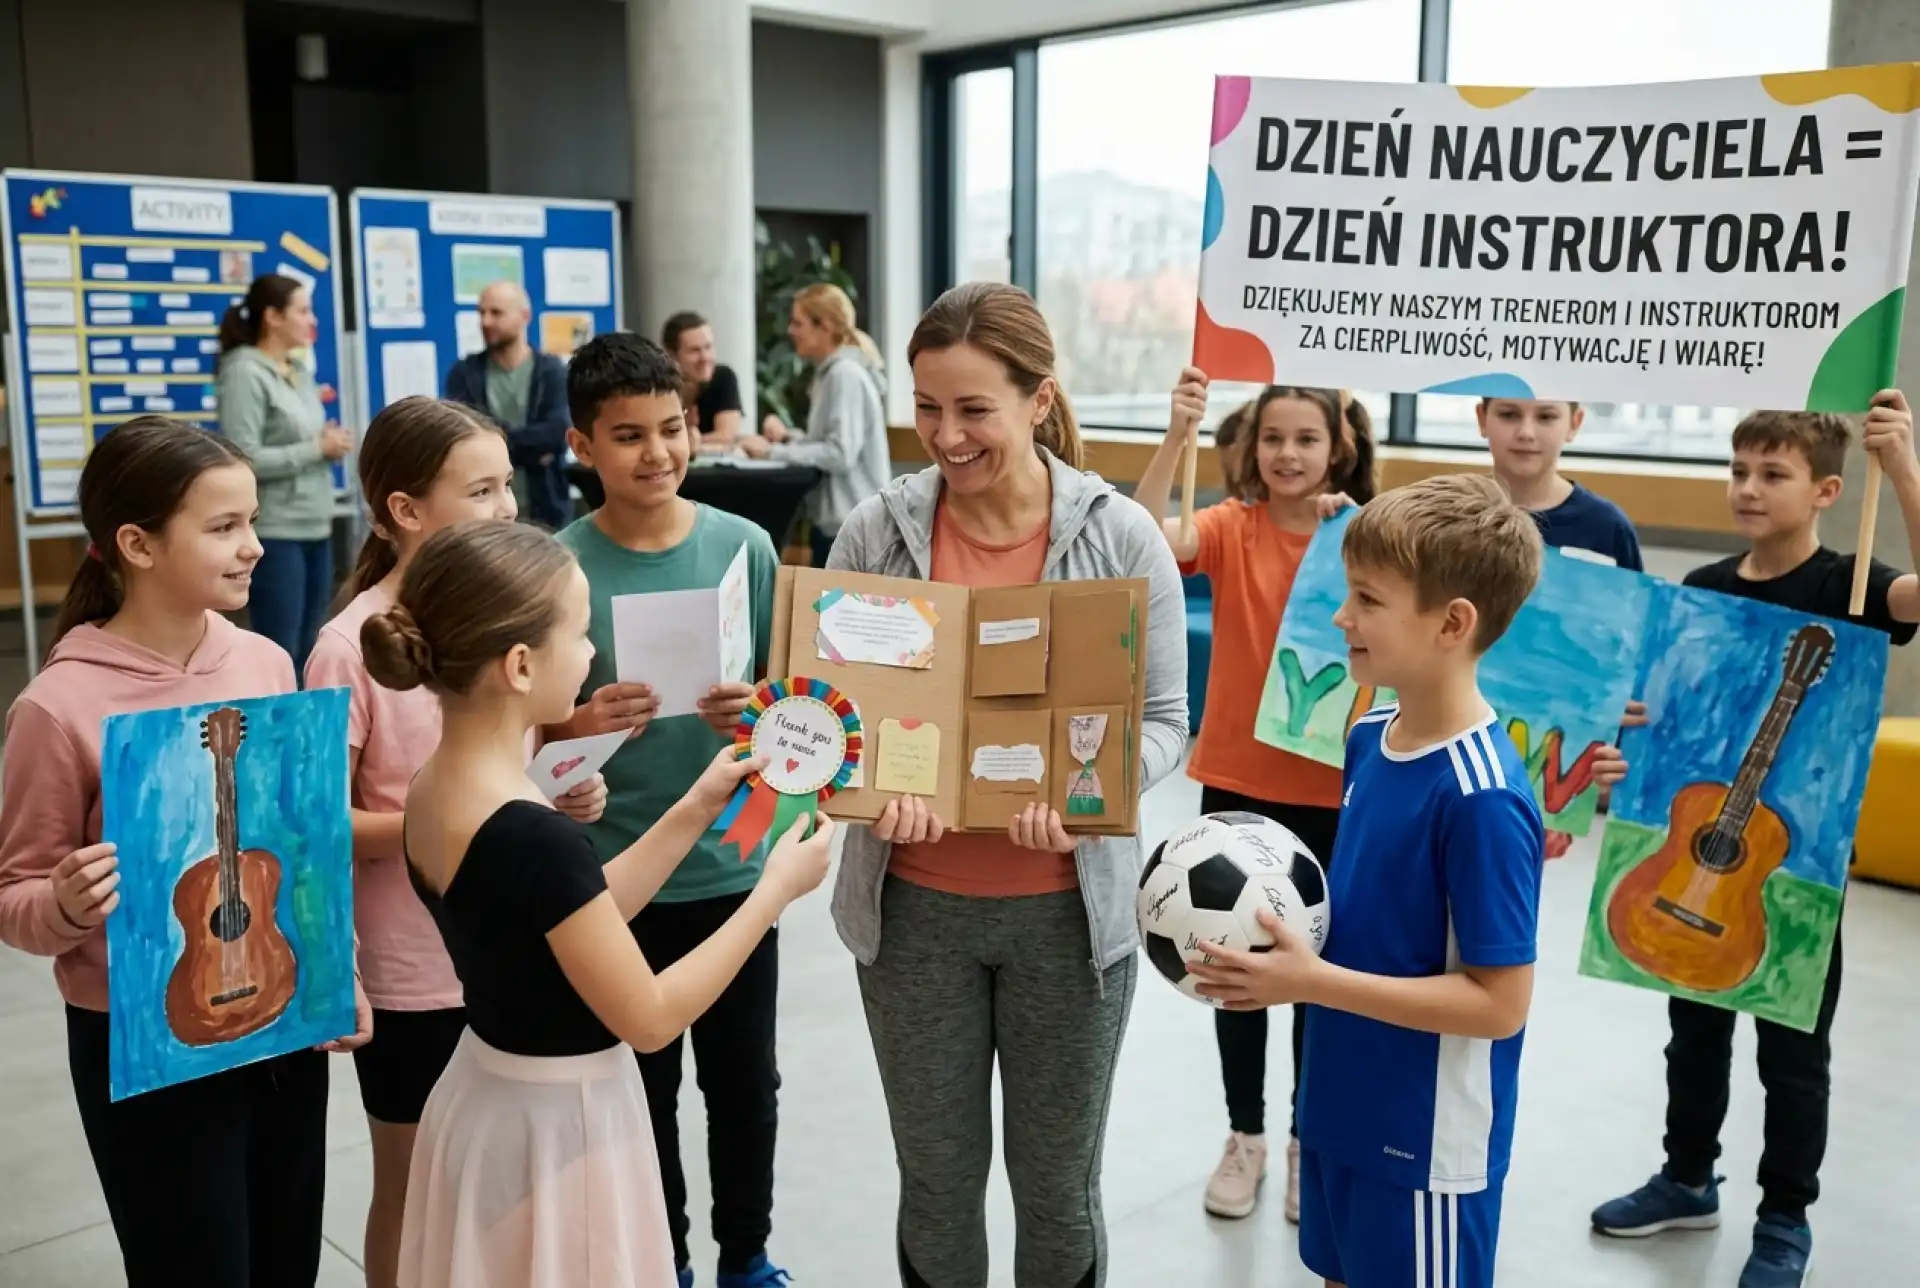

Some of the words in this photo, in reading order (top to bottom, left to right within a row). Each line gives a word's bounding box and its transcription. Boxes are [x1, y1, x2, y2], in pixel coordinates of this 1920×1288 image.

[1255, 107, 1413, 179] DZIEŃ
[1429, 114, 1824, 183] NAUCZYCIELA
[139, 199, 226, 221] ACTIVITY
[1247, 196, 1403, 267] DZIEŃ
[1419, 210, 1851, 274] INSTRUKTORA!
[1243, 285, 1383, 318] DZIĘKUJEMY
[1389, 293, 1482, 321] NASZYM
[1490, 297, 1617, 326] TRENEROM
[1624, 300, 1632, 326] I
[1639, 300, 1840, 329] INSTRUKTOROM
[1299, 324, 1326, 350] ZA
[1334, 324, 1493, 362] CIERPLIWOŚĆ,
[1502, 335, 1652, 371] MOTYWACJĘ
[1658, 339, 1666, 365] I
[1675, 339, 1765, 371] WIARĘ!
